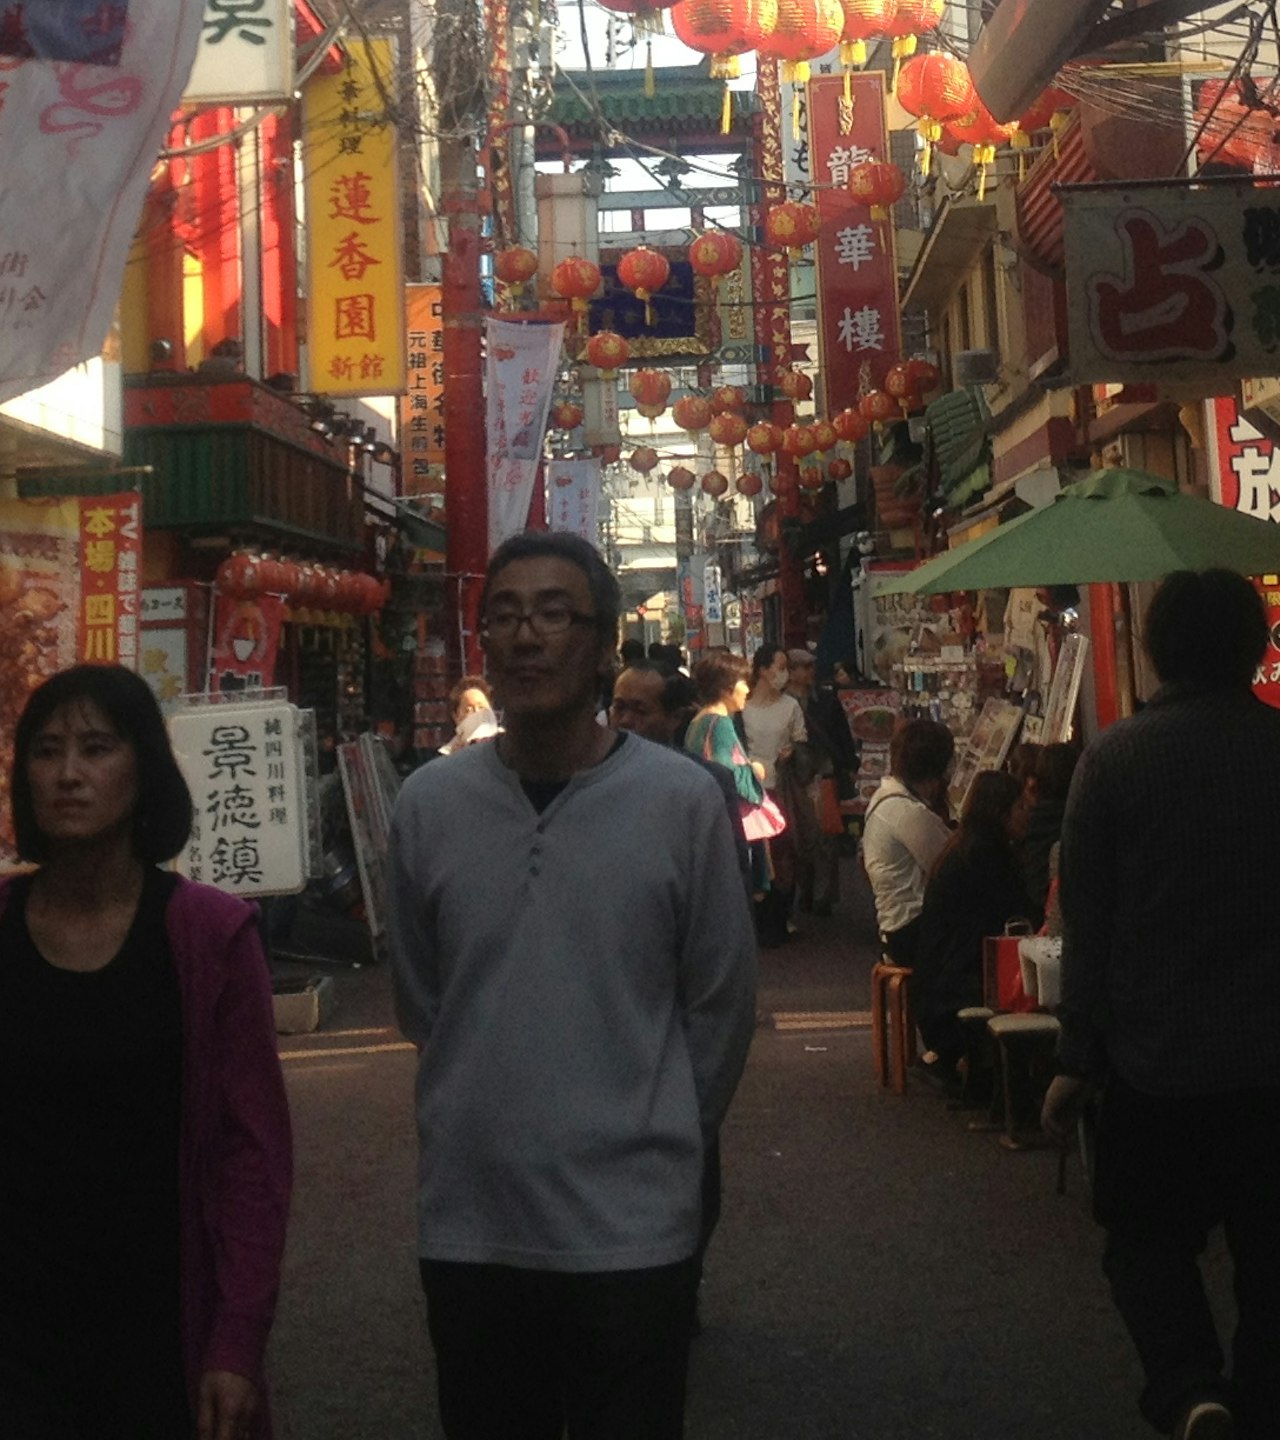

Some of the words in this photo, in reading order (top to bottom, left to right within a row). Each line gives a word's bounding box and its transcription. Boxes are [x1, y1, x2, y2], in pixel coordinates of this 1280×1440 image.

[327, 169, 382, 344] 蓮香園
[327, 351, 386, 383] 新館
[202, 724, 264, 886] 景徳鎮
